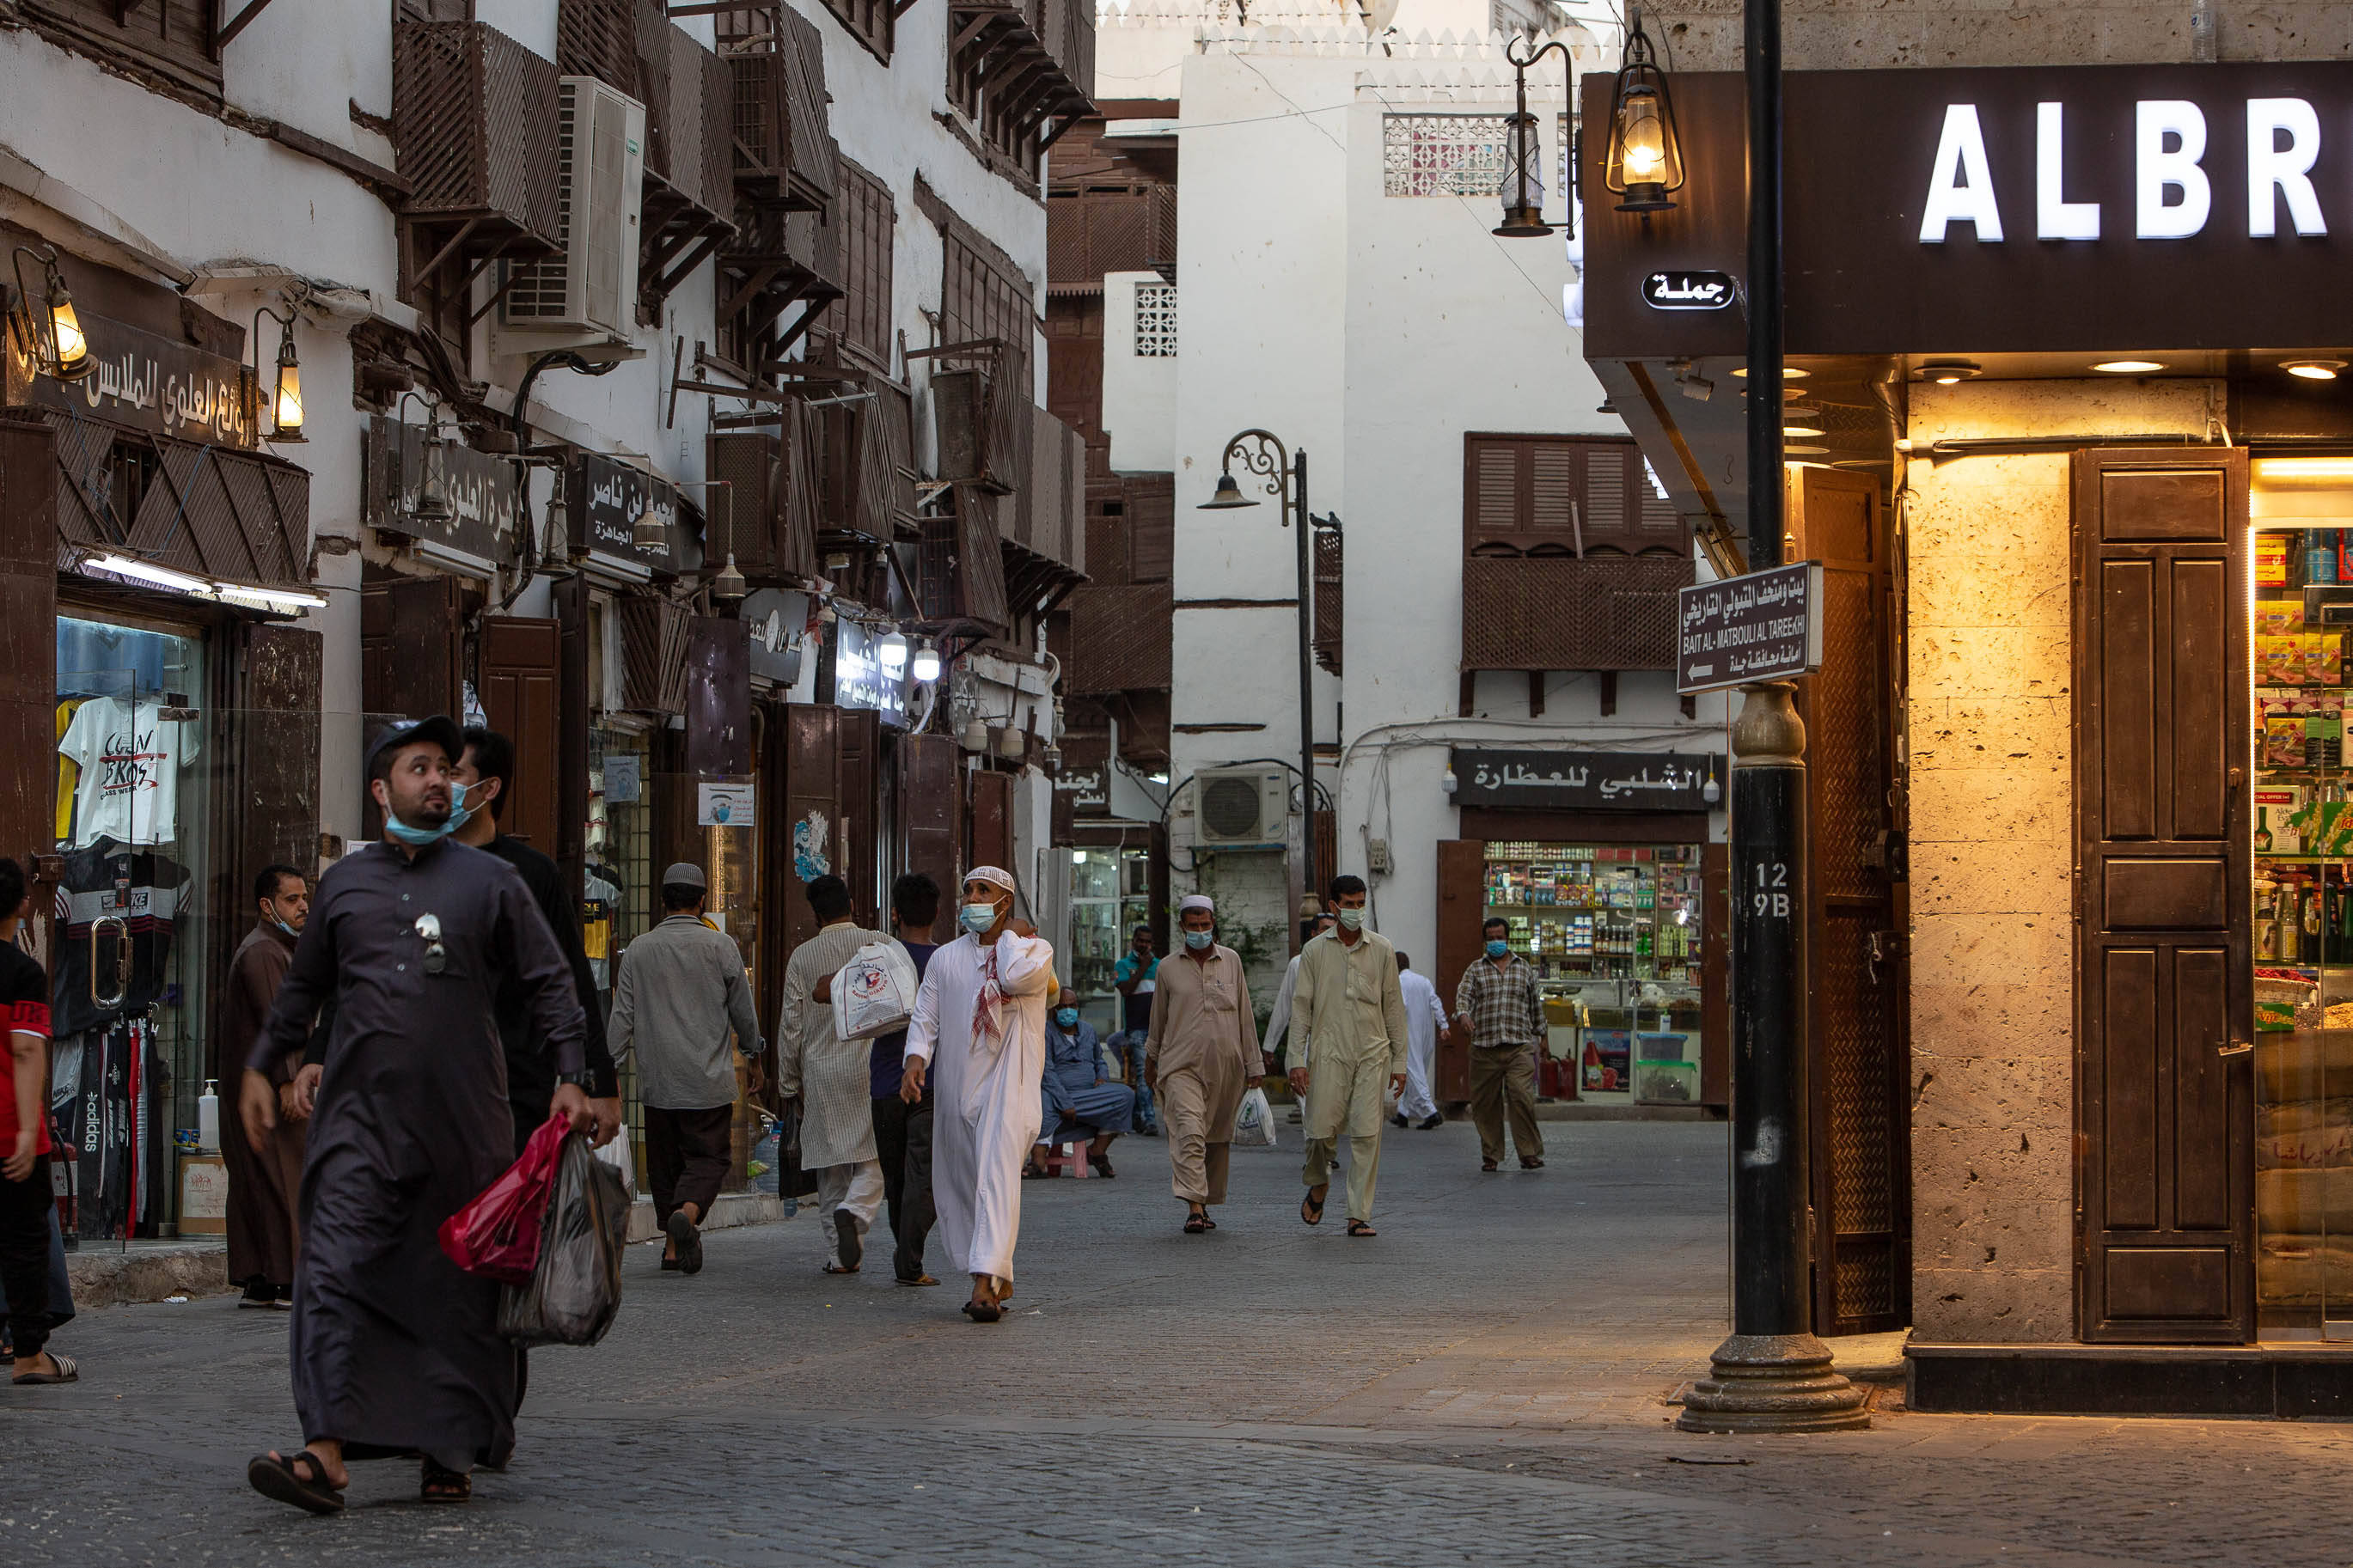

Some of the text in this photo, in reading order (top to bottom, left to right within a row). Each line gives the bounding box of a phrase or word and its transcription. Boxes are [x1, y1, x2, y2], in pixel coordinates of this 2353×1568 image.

[1919, 98, 2328, 243] ALBR
[1652, 274, 1724, 302] جملة
[588, 474, 623, 510] ناصر
[595, 519, 633, 546] الجاهزة
[1683, 577, 1805, 632] بيت ومتحف المتبولي التاريخي
[1683, 633, 1702, 656] BAIT
[1717, 624, 1757, 650] MATBOULI
[1757, 621, 1767, 641] AL
[1768, 613, 1806, 640] TAREEKHI
[1729, 640, 1801, 675] أمانة محافظة جدة
[1475, 763, 1702, 799] الشلبي للعطارة
[1757, 863, 1787, 887] 12
[1754, 893, 1789, 918] 9B
[84, 1101, 101, 1152] adidas
